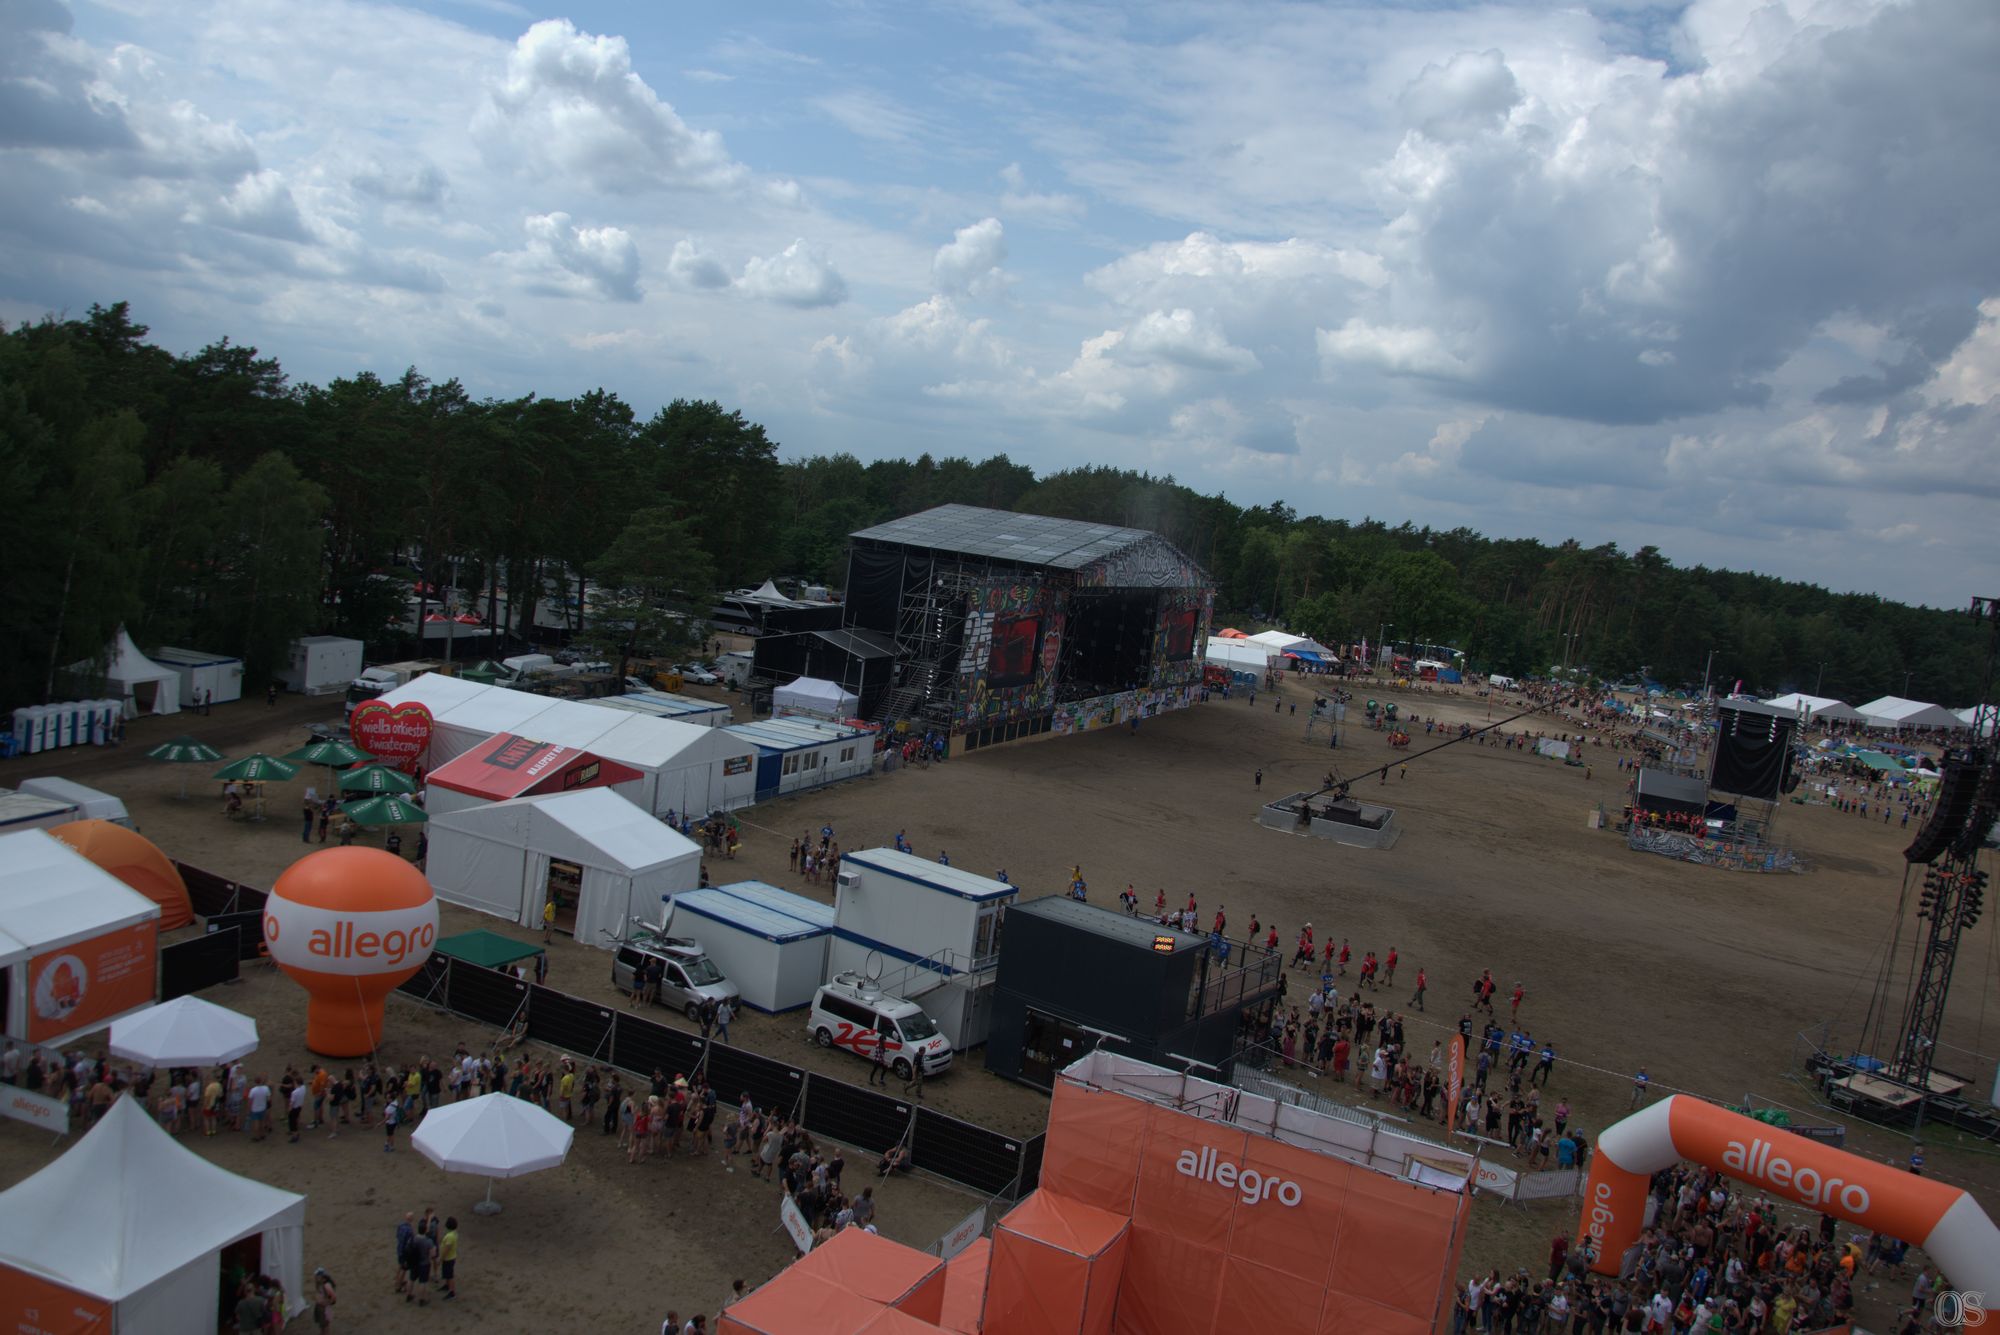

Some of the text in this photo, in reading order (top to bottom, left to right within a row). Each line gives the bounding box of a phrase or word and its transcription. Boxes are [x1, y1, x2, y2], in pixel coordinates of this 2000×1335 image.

[960, 611, 995, 674] 25
[308, 921, 434, 965] allegro
[1176, 1145, 1302, 1207] allegro
[1722, 1138, 1870, 1214] allegro
